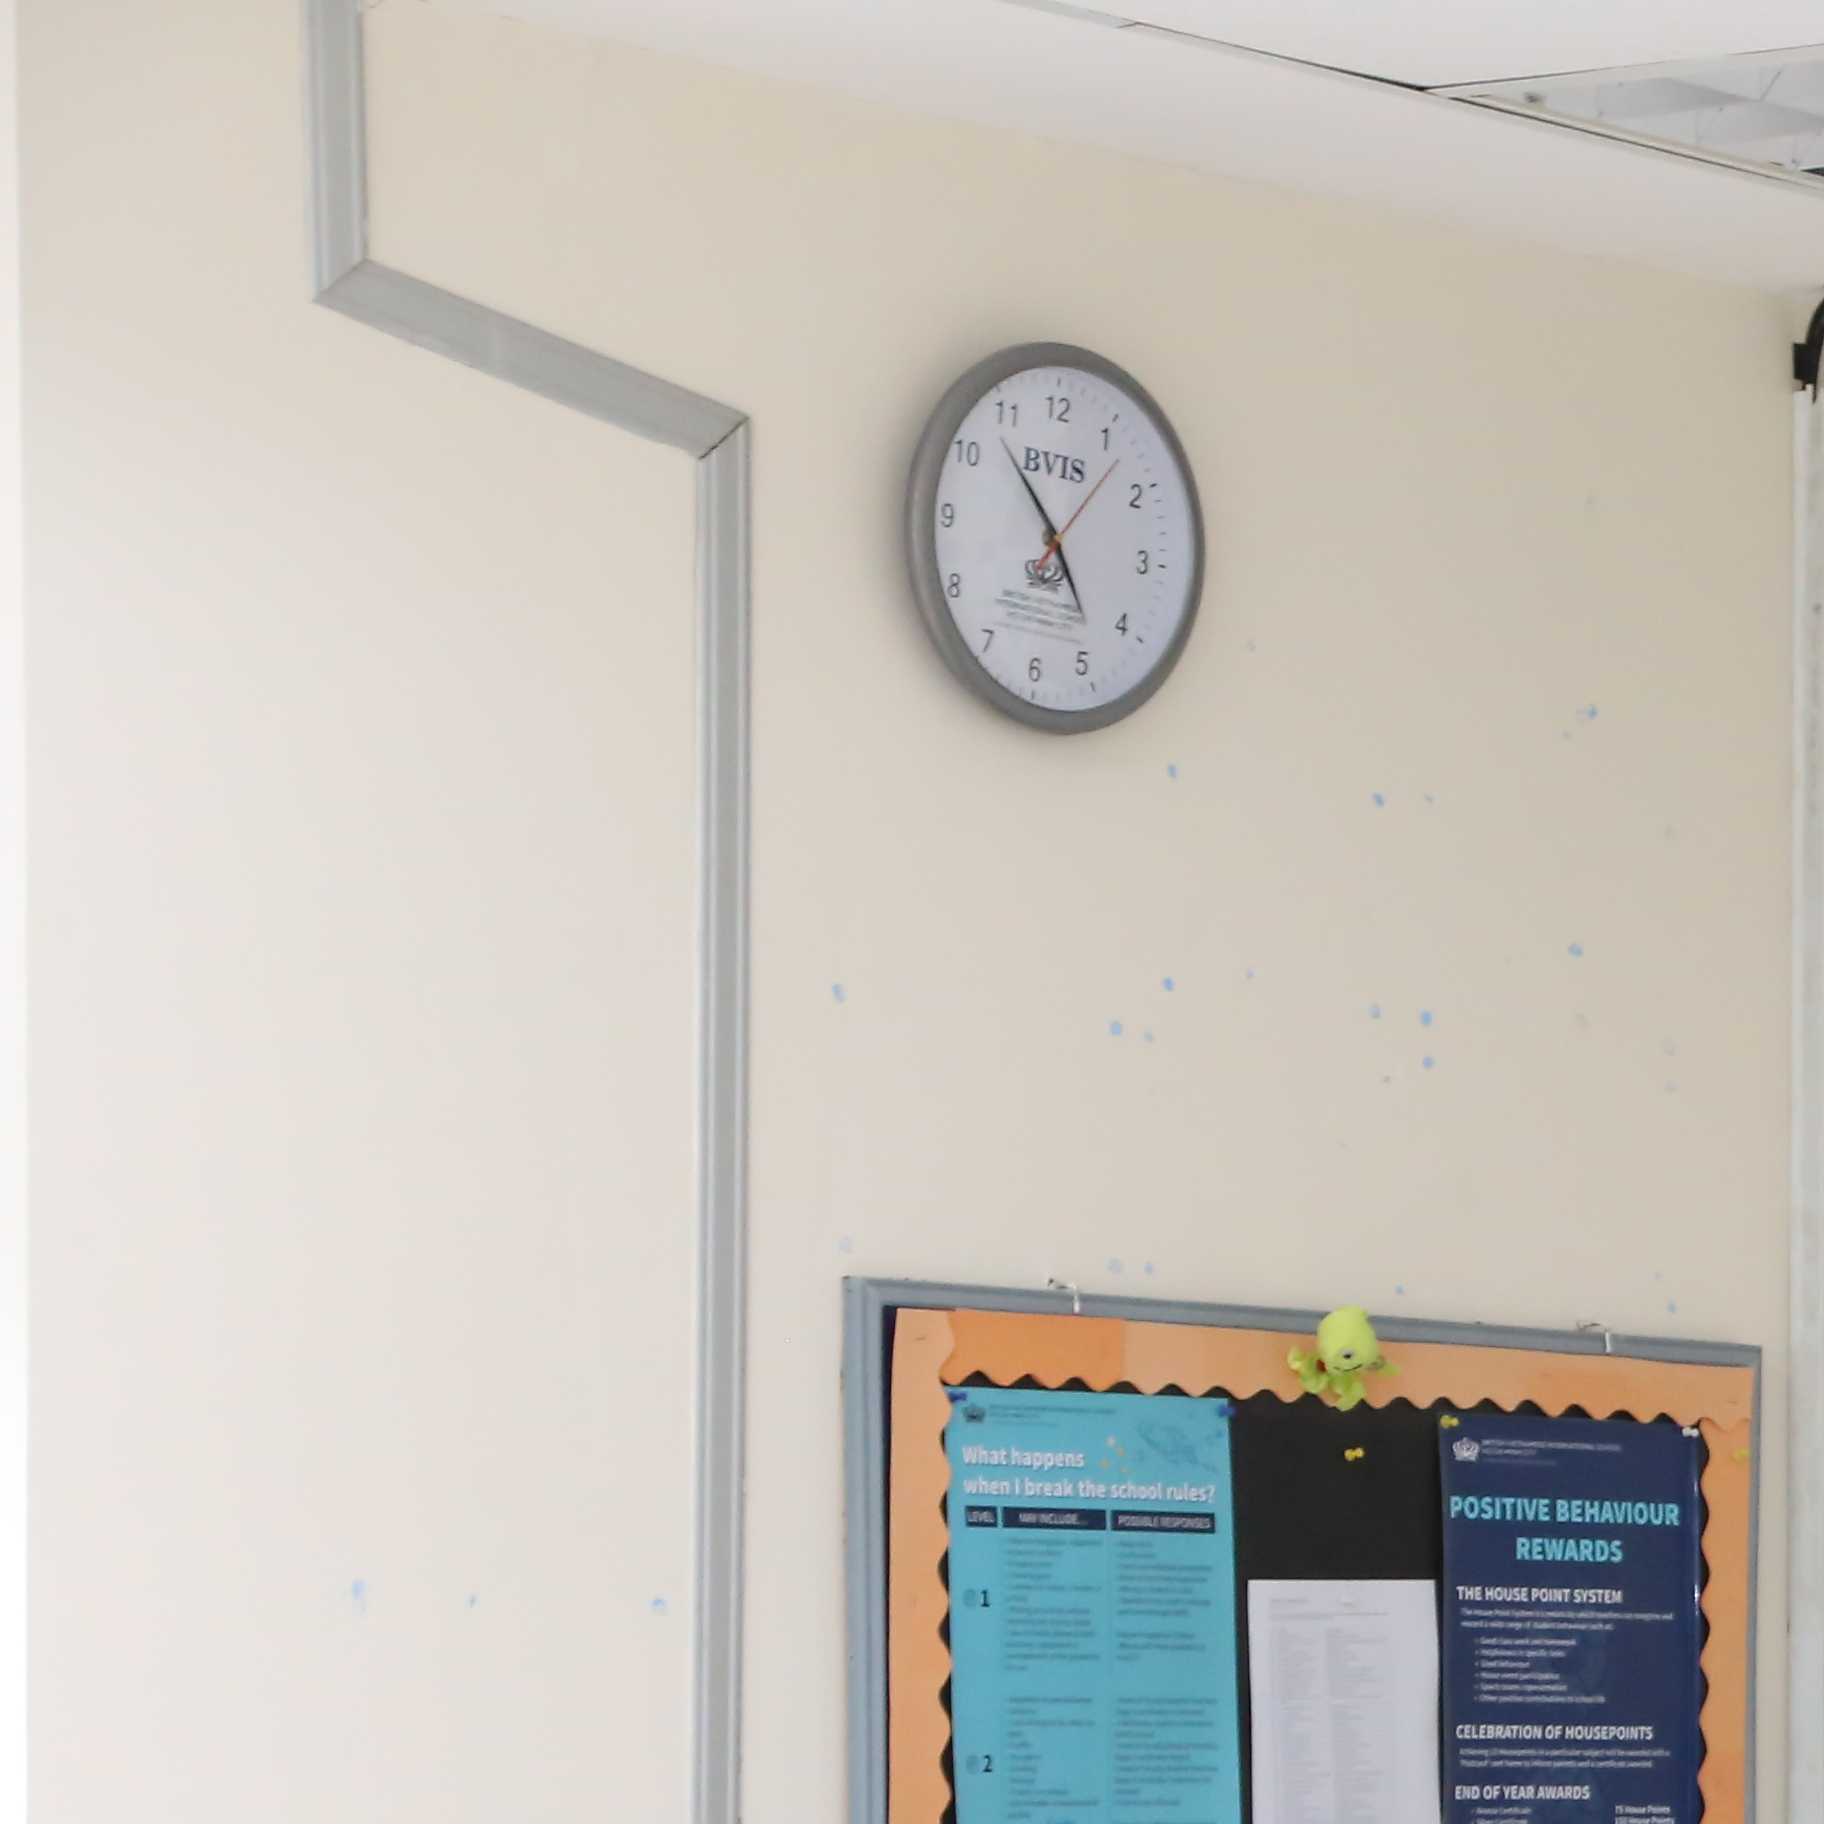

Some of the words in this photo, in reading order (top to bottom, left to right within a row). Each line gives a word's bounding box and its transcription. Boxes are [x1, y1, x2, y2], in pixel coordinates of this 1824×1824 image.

[995, 400, 1018, 428] 11
[1045, 396, 1070, 423] 12
[1101, 427, 1110, 451] 1
[954, 439, 980, 466] 10
[1023, 446, 1086, 484] BVIS
[1129, 484, 1142, 509] 2
[941, 503, 954, 528] 9
[1136, 550, 1149, 575] 3
[947, 573, 961, 599] 8
[1115, 613, 1128, 636] 4
[981, 629, 995, 653] 7
[1028, 657, 1042, 682] 6
[1075, 651, 1089, 676] 5
[961, 1446, 1007, 1466] What
[1011, 1449, 1084, 1471] happens
[963, 1478, 1010, 1495] when
[1024, 1478, 1073, 1497] break
[1078, 1480, 1106, 1498] the
[1110, 1482, 1161, 1500] school
[1167, 1483, 1216, 1502] rules?
[1450, 1496, 1549, 1521] POSITIVE
[1556, 1500, 1680, 1526] BEHAVIOUR
[1516, 1538, 1623, 1563] REWARDS
[979, 1590, 990, 1607] 1
[1456, 1586, 1482, 1600] THE
[1485, 1587, 1528, 1601] HOUSE
[1531, 1588, 1570, 1602] POINT
[1573, 1589, 1624, 1604] SYSTEM
[1456, 1725, 1542, 1739] CELEBRATION
[1544, 1725, 1561, 1739] OF
[1564, 1726, 1653, 1740] HOUSEPOINTS
[982, 1755, 994, 1773] 2
[1455, 1785, 1480, 1799] END
[1483, 1785, 1501, 1799] OF
[1503, 1785, 1535, 1799] YEAR
[1537, 1785, 1590, 1799] AWARDS
